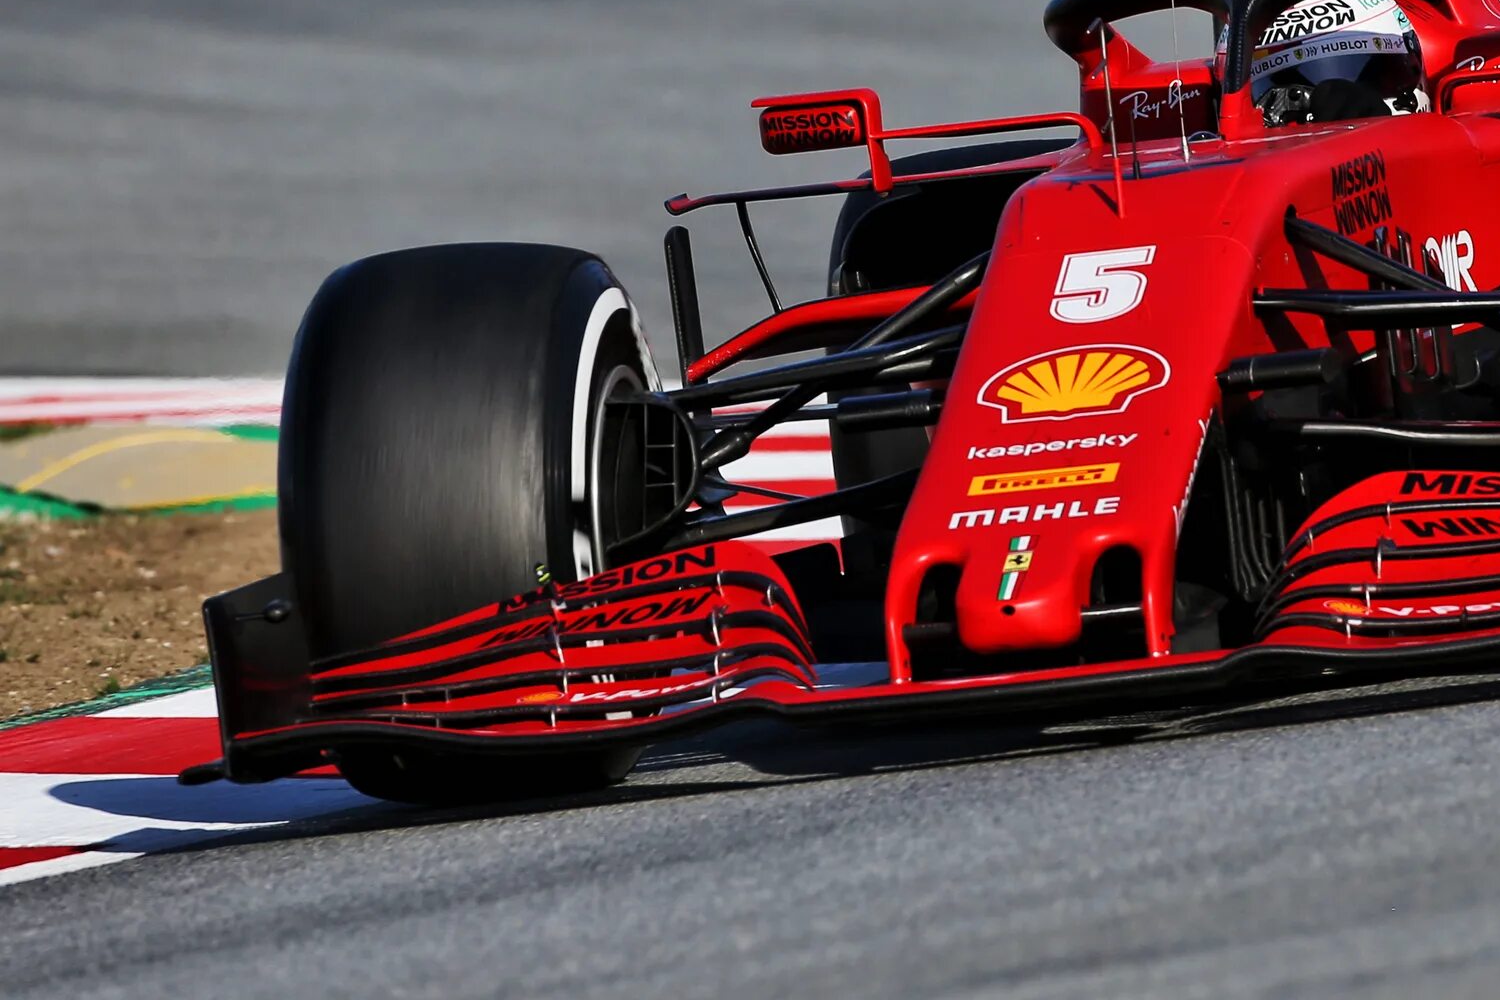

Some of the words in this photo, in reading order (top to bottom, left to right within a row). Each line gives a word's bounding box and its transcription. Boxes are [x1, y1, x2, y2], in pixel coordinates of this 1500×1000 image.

[1275, 0, 1351, 27] SSION
[1321, 40, 1368, 54] HUBLOT
[1120, 79, 1200, 119] Ray-Ban
[764, 111, 855, 133] MISSION
[1331, 149, 1386, 200] MISSION
[1334, 187, 1392, 235] WINNOW
[1050, 245, 1157, 323] 5
[967, 433, 1138, 459] kaspersky
[948, 496, 1121, 529] MAHLE
